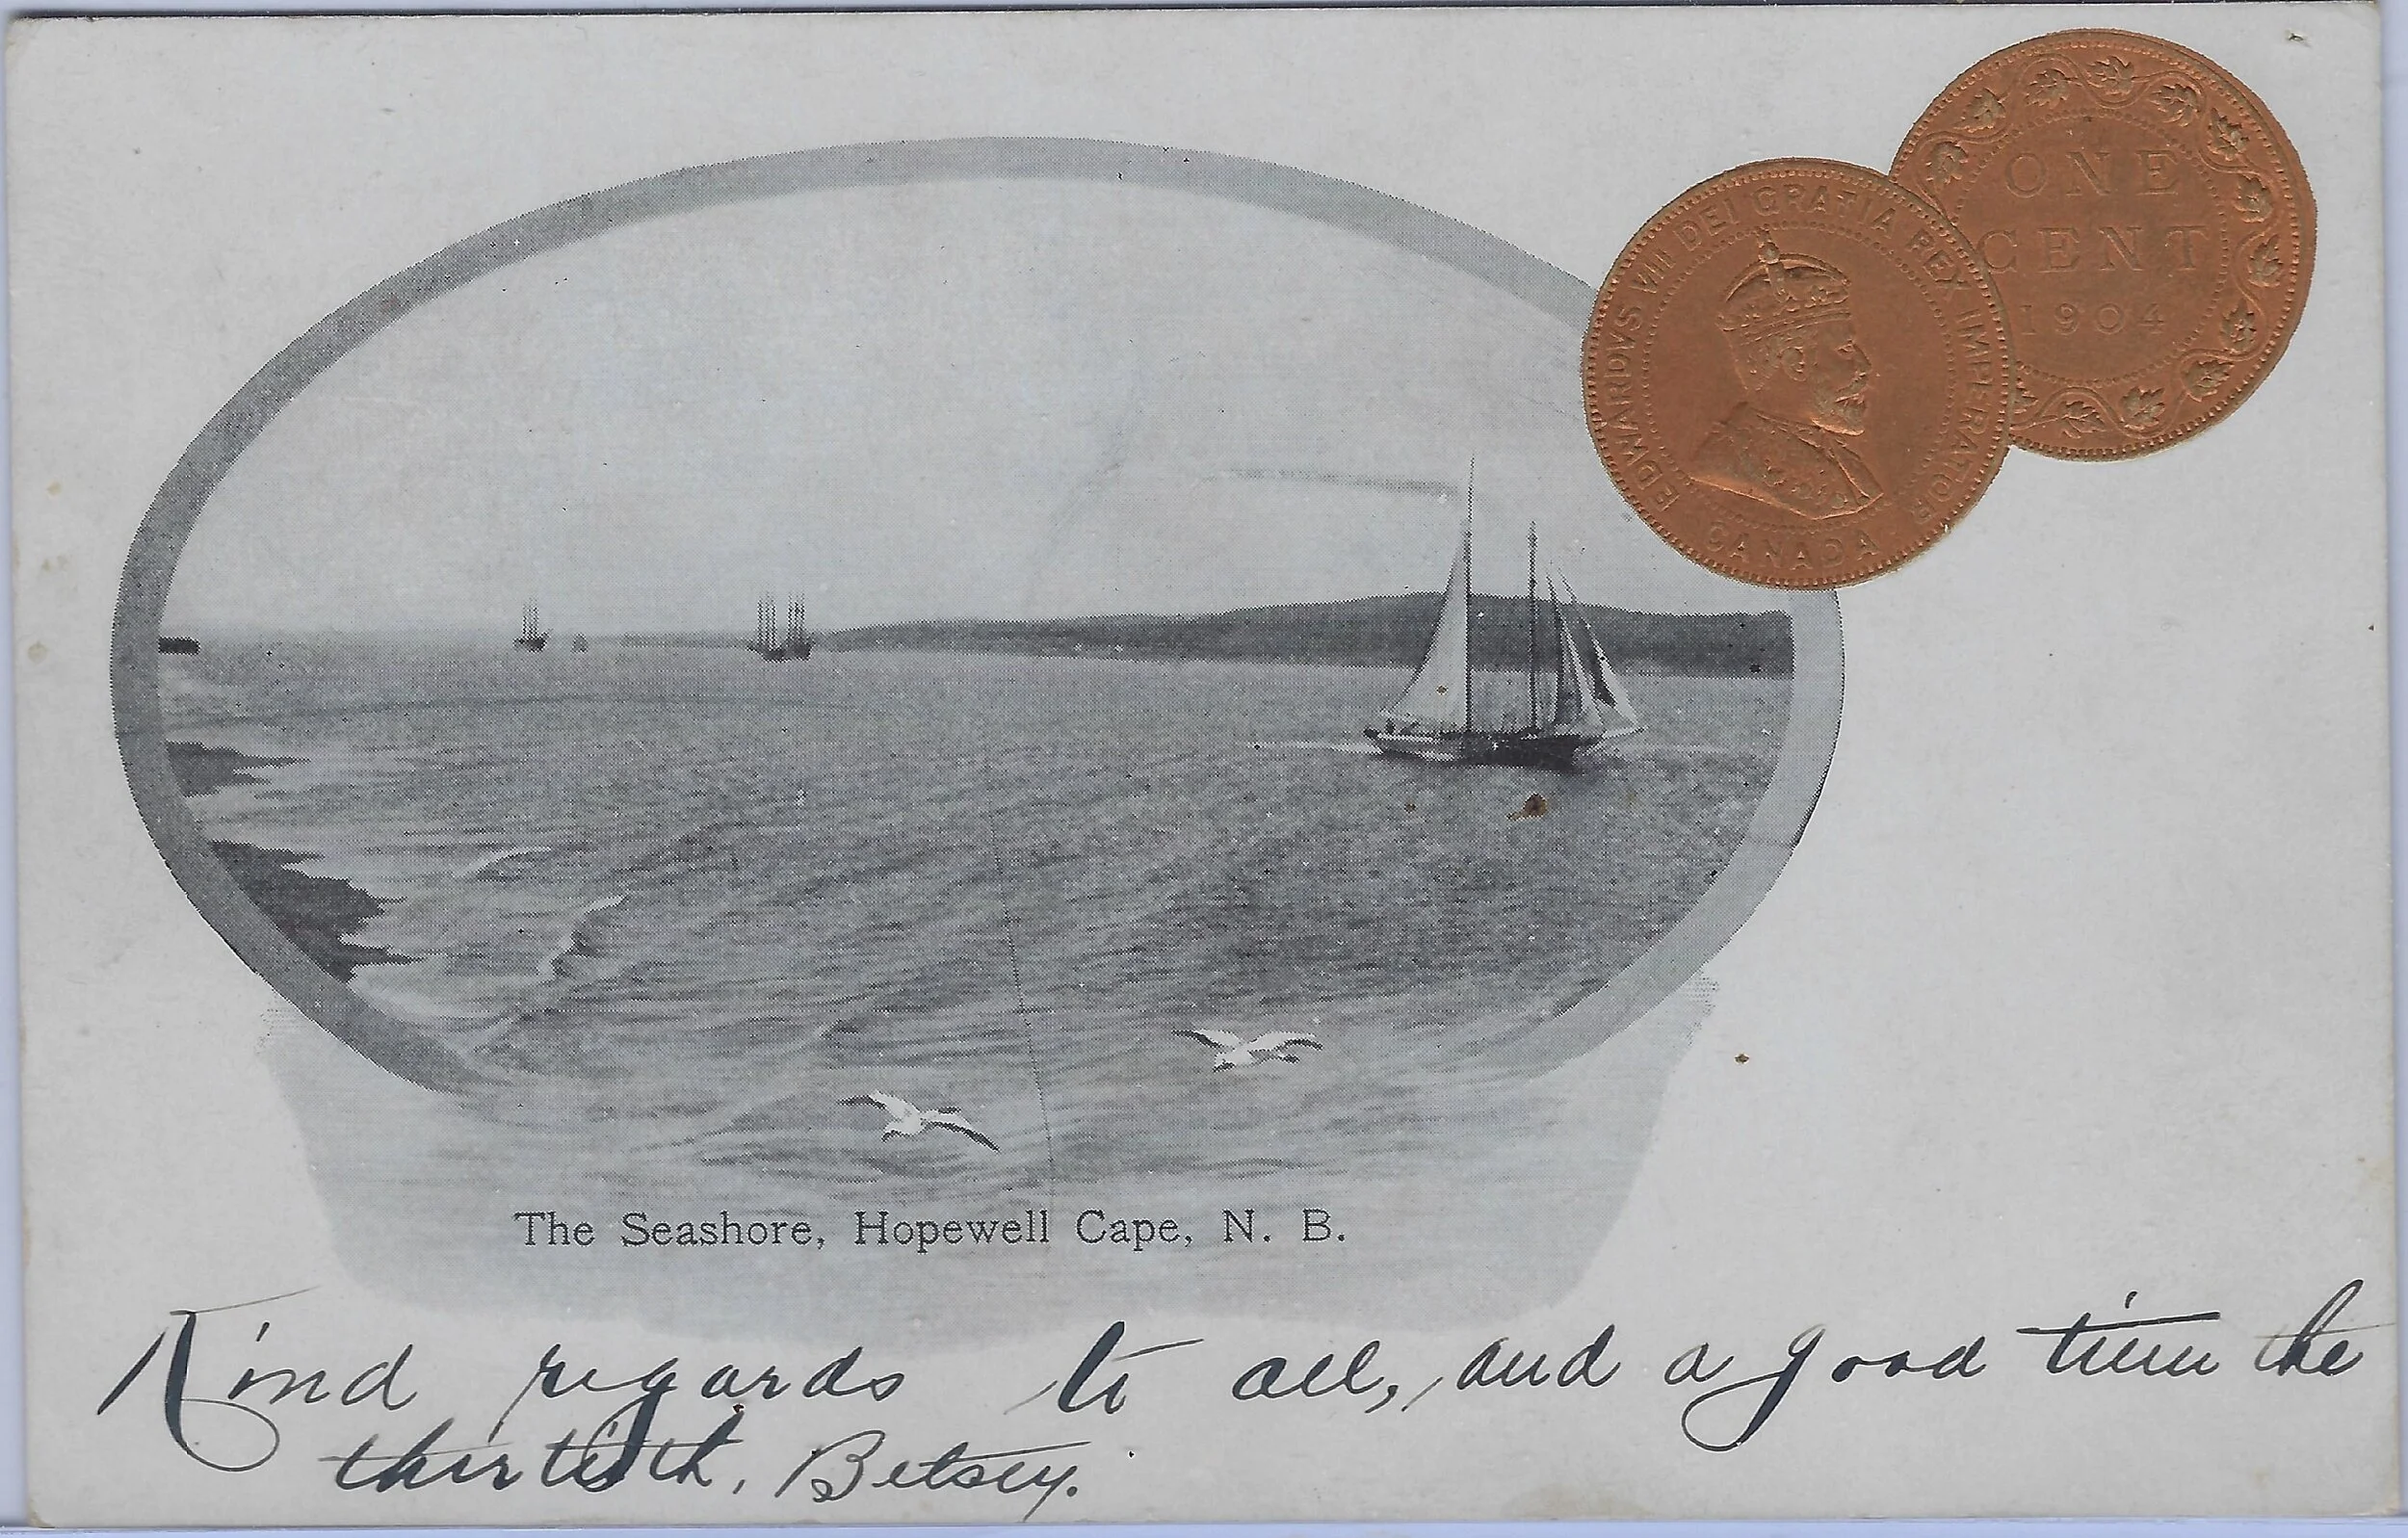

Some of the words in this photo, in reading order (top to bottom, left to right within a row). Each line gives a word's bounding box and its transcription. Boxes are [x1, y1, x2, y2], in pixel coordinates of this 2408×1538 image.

[2005, 149, 2181, 198] ONE
[1978, 225, 2210, 274] CENT
[1604, 305, 1681, 512] EDWARDVS
[1671, 200, 1735, 252] DEI
[1748, 184, 1898, 241] GRATIA
[1903, 229, 1967, 293] REX
[2021, 302, 2167, 337] 1904
[1704, 524, 1880, 572] CANADA
[514, 1212, 595, 1246] The
[619, 1211, 826, 1250] Seashore,
[854, 1210, 1050, 1252] Hopewell
[1076, 1211, 1193, 1252] Cape,
[1222, 1211, 1272, 1244] N.
[1300, 1211, 1347, 1243] B.
[2254, 1278, 2400, 1377] the
[96, 1286, 418, 1472] Kind
[1231, 1339, 1400, 1413] all,
[1664, 1342, 1735, 1385] a
[1682, 1322, 1986, 1452] good
[488, 1343, 905, 1492] regards
